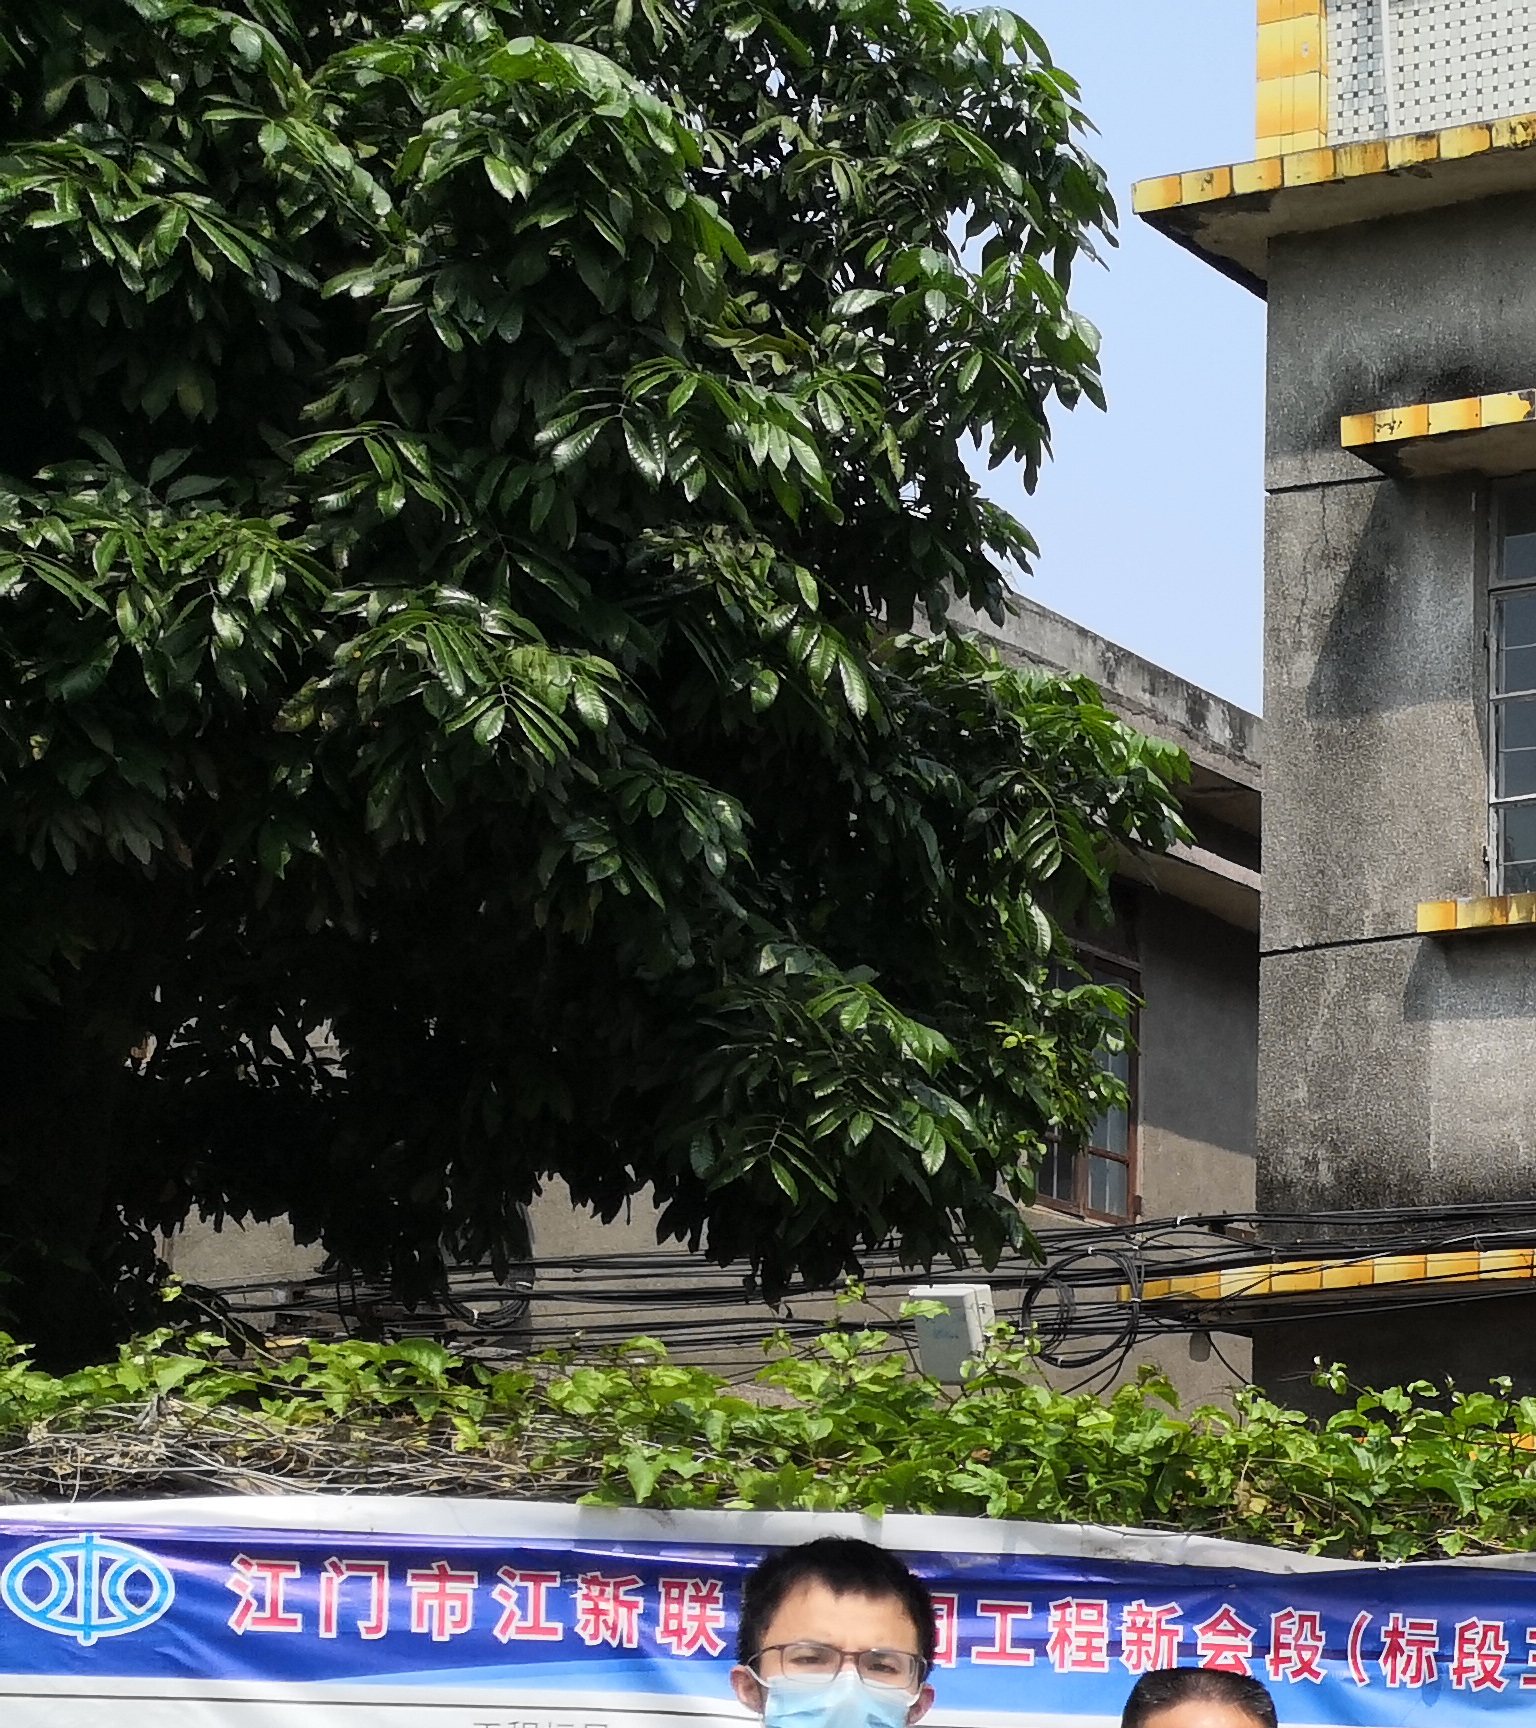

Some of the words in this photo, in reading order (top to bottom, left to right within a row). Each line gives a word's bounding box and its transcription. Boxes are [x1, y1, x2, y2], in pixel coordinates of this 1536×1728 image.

[226, 1553, 729, 1658] 江门市江新联
